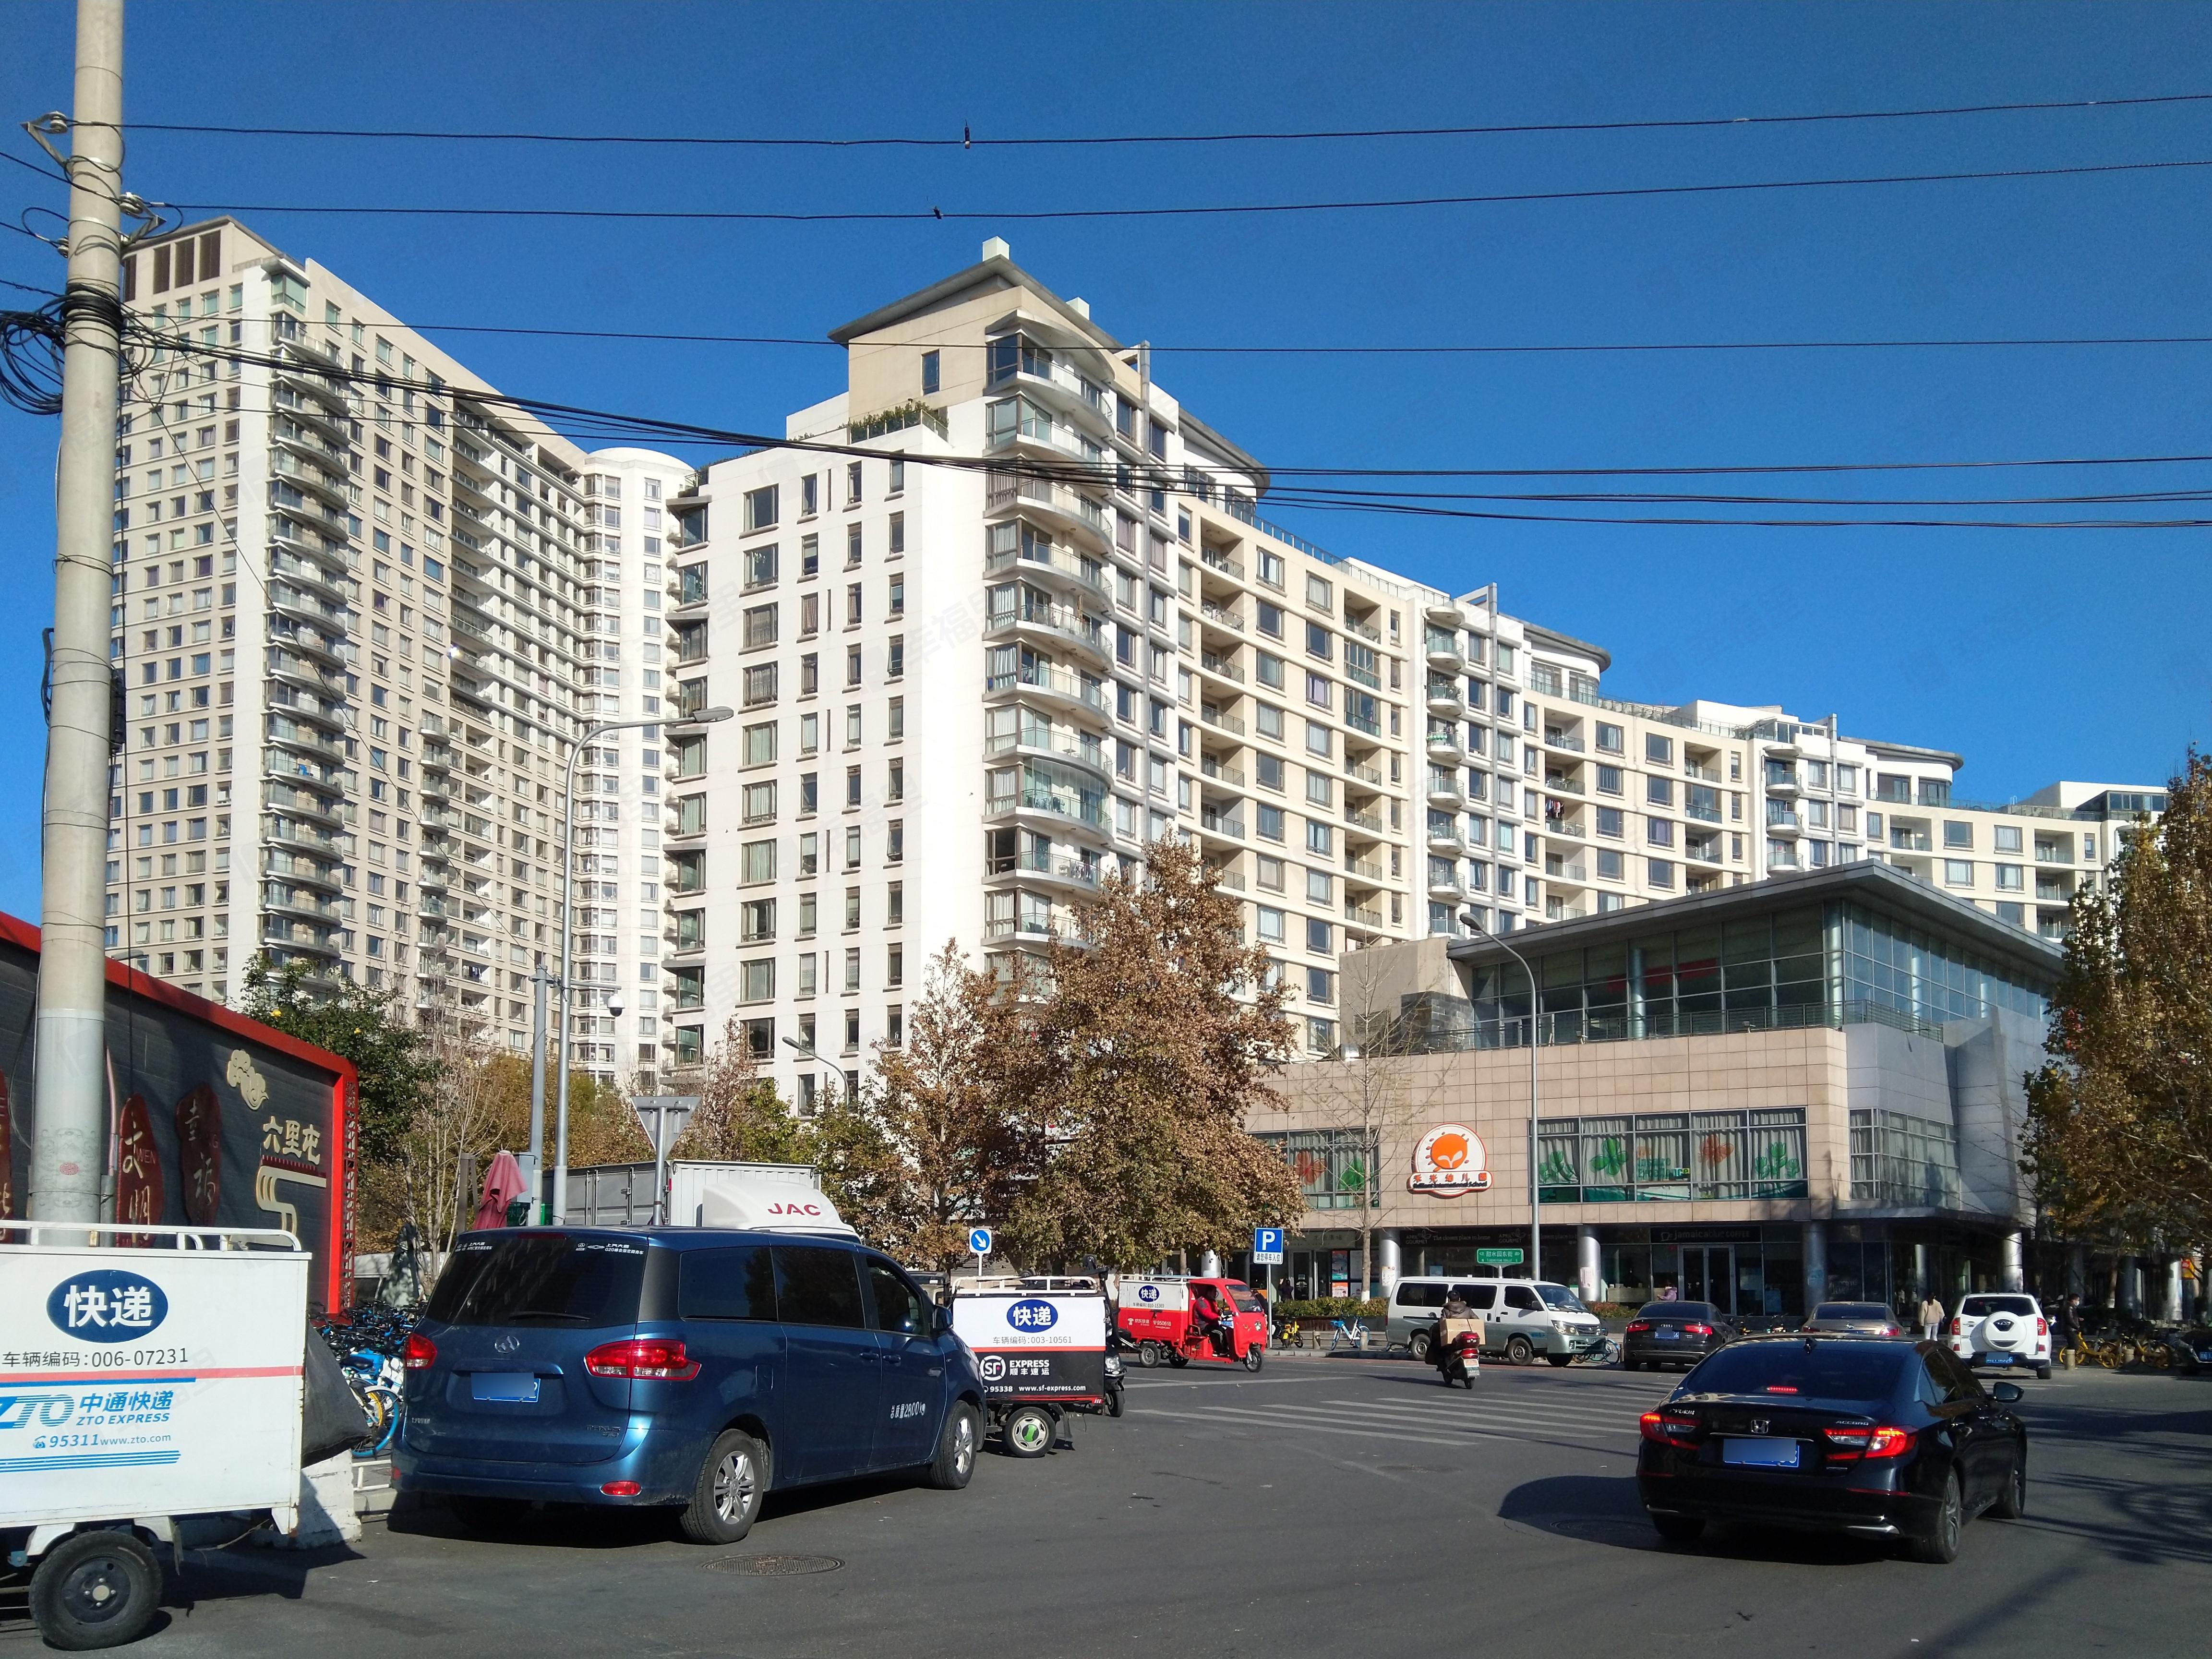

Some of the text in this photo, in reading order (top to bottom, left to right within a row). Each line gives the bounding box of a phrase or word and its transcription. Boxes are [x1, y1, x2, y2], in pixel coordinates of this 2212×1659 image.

[263, 1116, 321, 1165] 六里屯
[768, 1202, 821, 1216] JAC
[1262, 1231, 1275, 1250] P
[1256, 1253, 1280, 1262] 请您停车入位
[1141, 1288, 1157, 1299] 快递
[63, 1285, 152, 1328] 快递
[1013, 1306, 1052, 1327] 快递
[1010, 1359, 1050, 1368] EXPRESS
[1010, 1368, 1050, 1376] 顺丰速运
[79, 1390, 174, 1413] 中通快递
[76, 1413, 170, 1426] ZTO EXPRESS
[49, 1433, 171, 1448] 95311 www.zto.com
